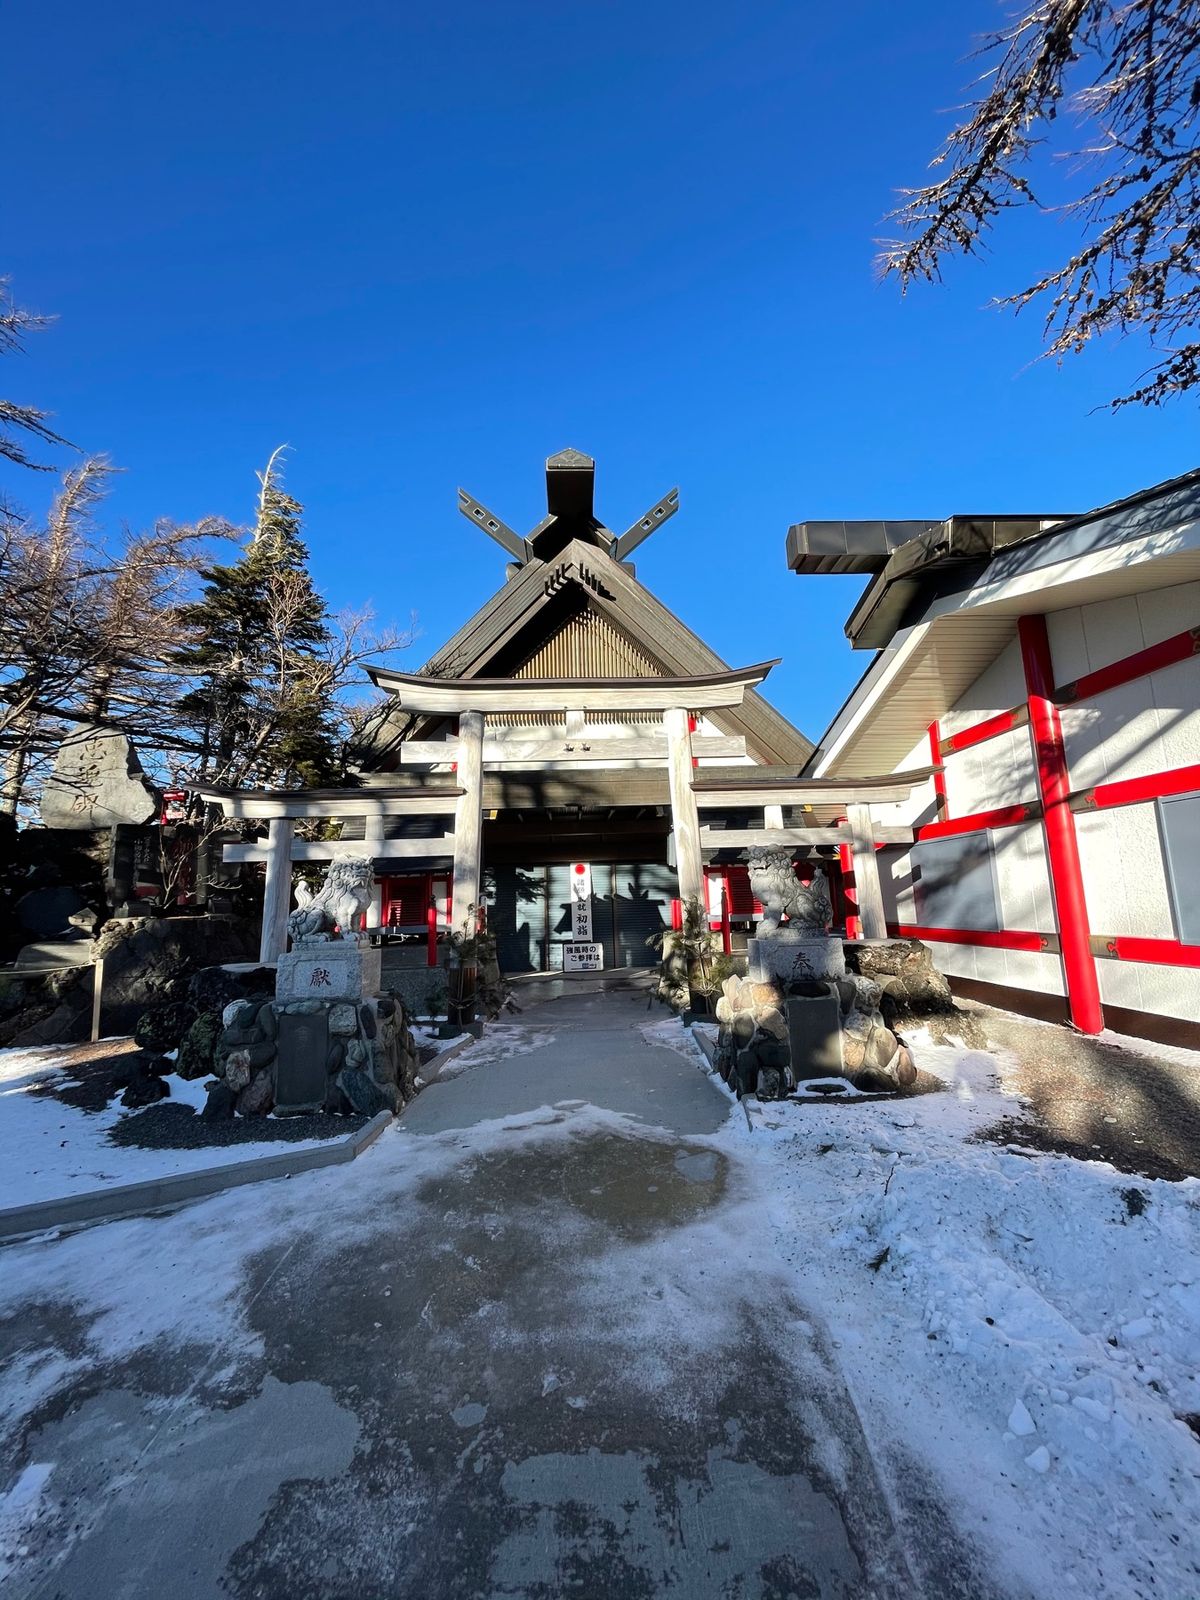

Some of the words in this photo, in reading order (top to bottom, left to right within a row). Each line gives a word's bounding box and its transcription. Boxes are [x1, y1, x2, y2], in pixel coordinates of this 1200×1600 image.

[566, 946, 596, 954] 強風時の
[792, 951, 815, 974] 奉
